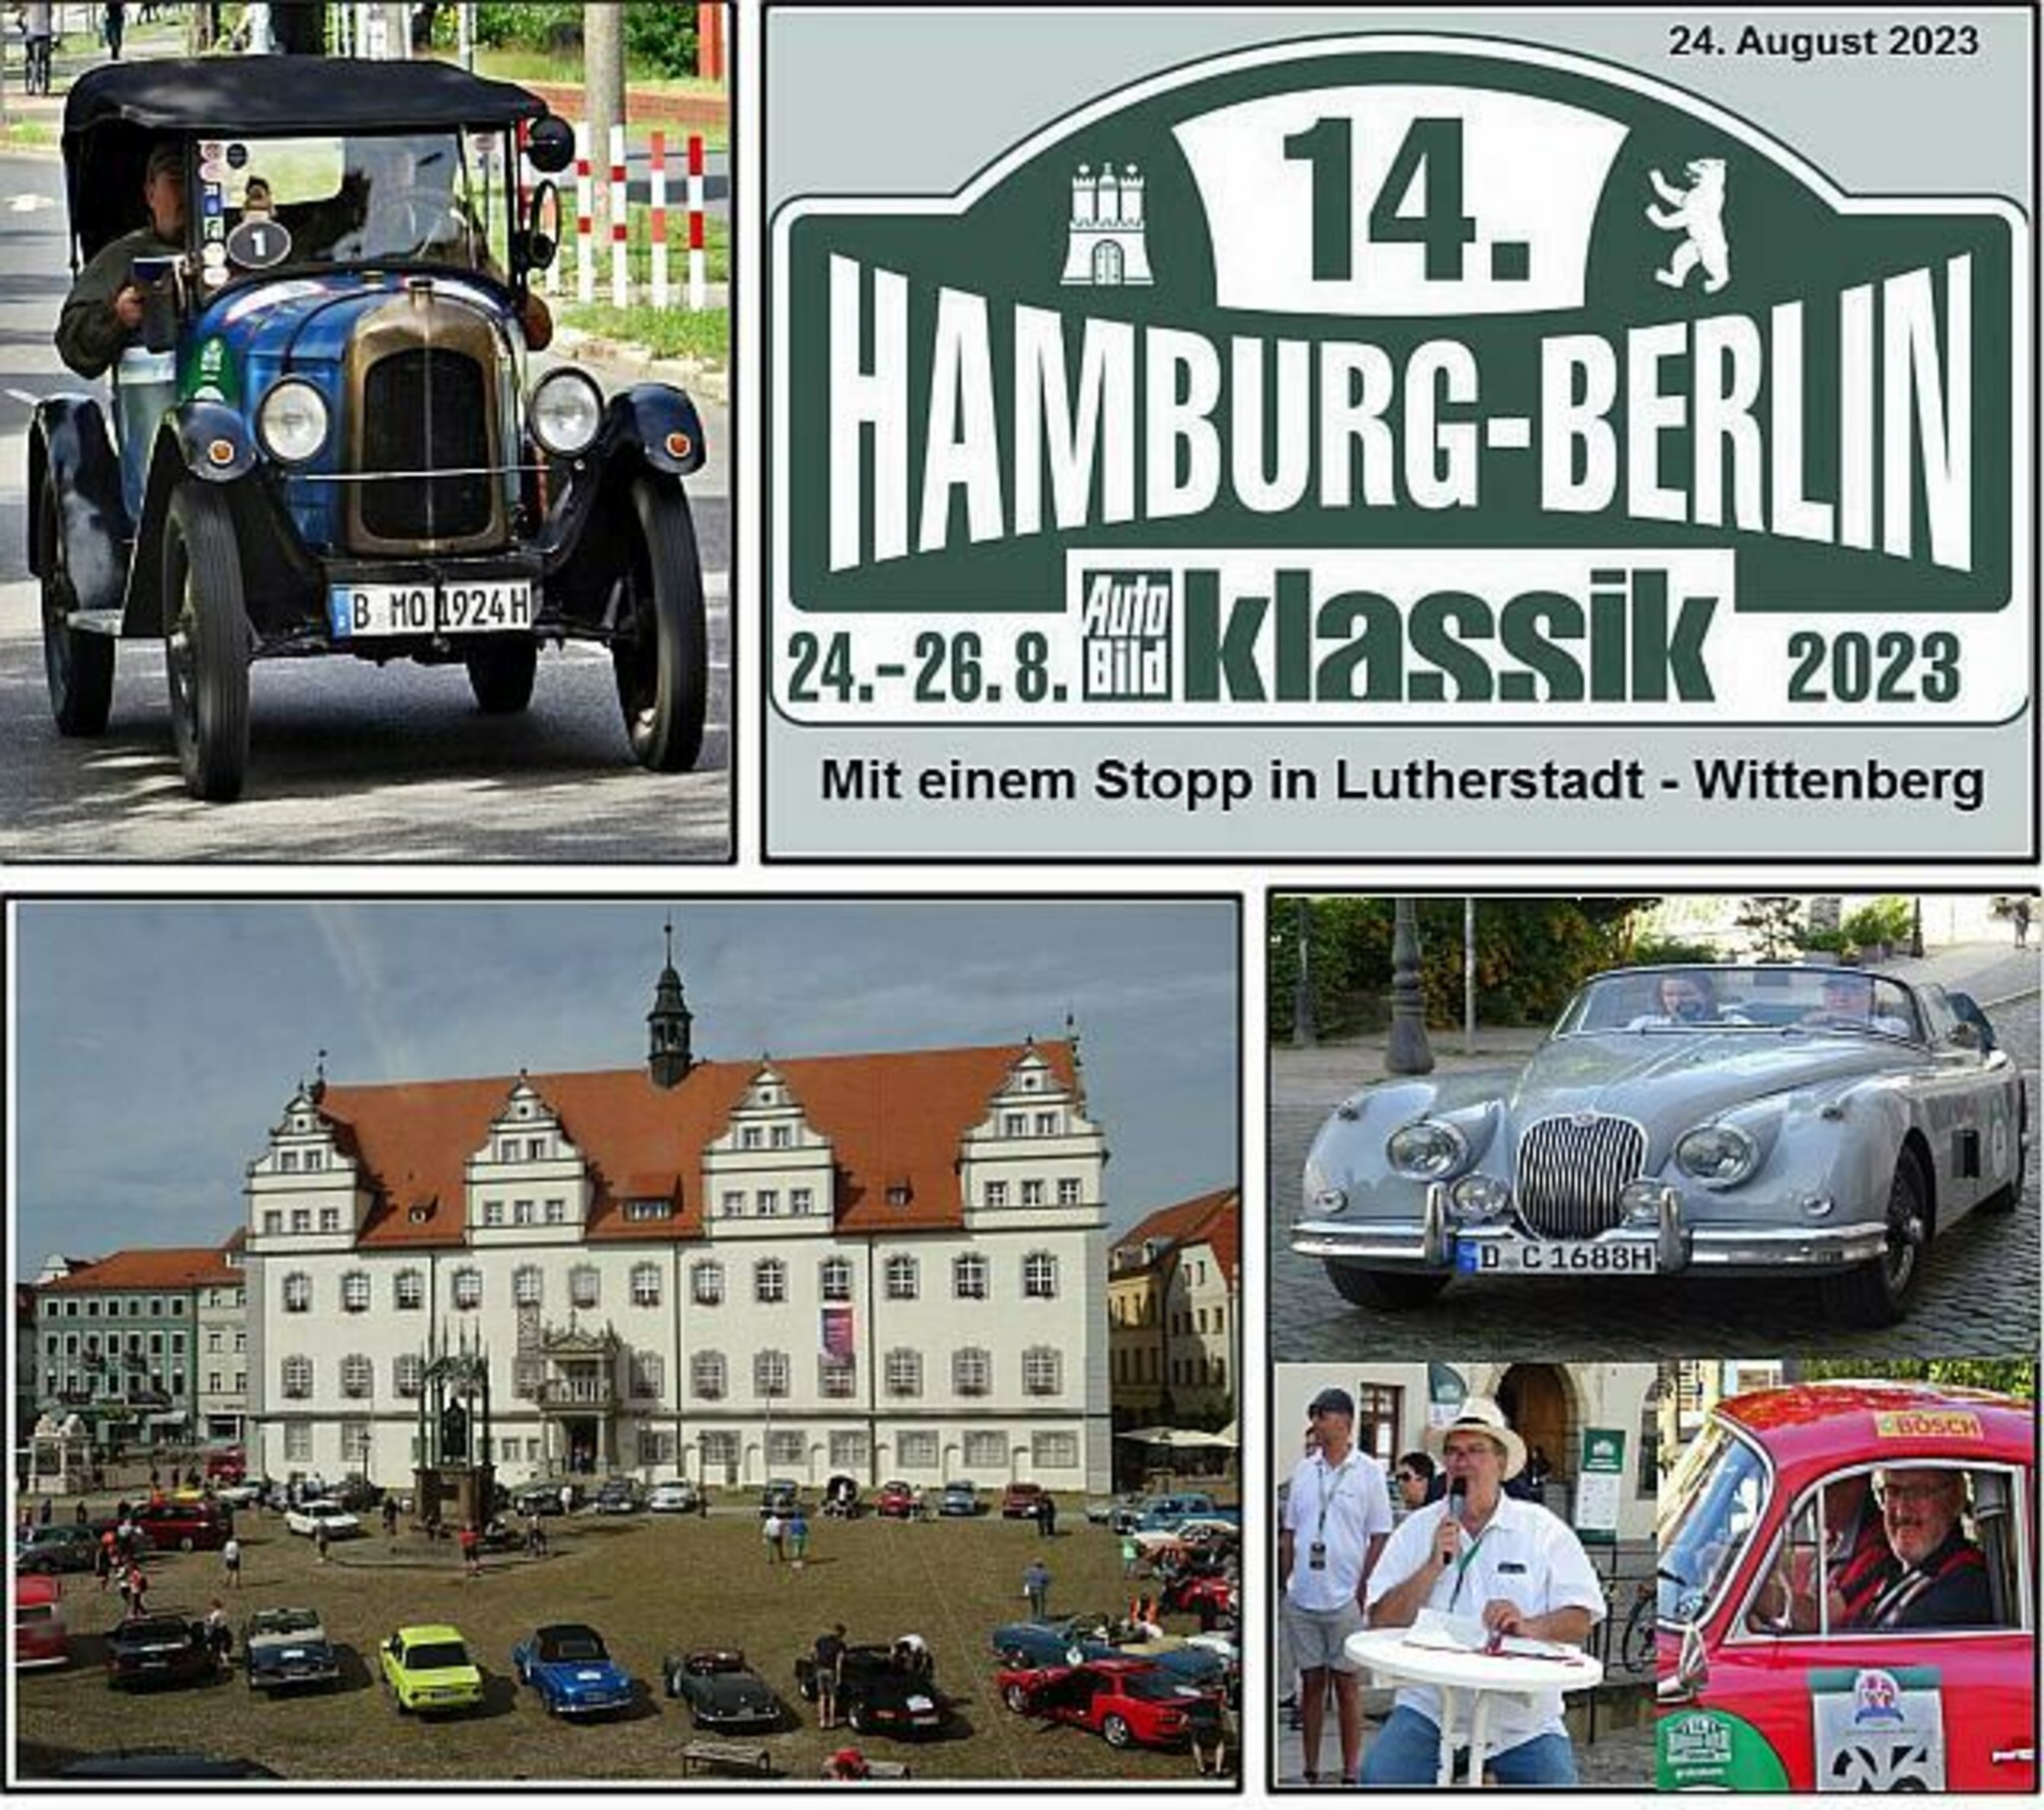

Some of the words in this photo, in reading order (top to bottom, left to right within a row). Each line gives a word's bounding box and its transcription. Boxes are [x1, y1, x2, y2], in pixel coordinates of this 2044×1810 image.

[252, 228, 266, 256] 1
[353, 593, 370, 629] B
[390, 590, 426, 627] MO
[1482, 1244, 1500, 1268] D
[1522, 1245, 1542, 1269] C
